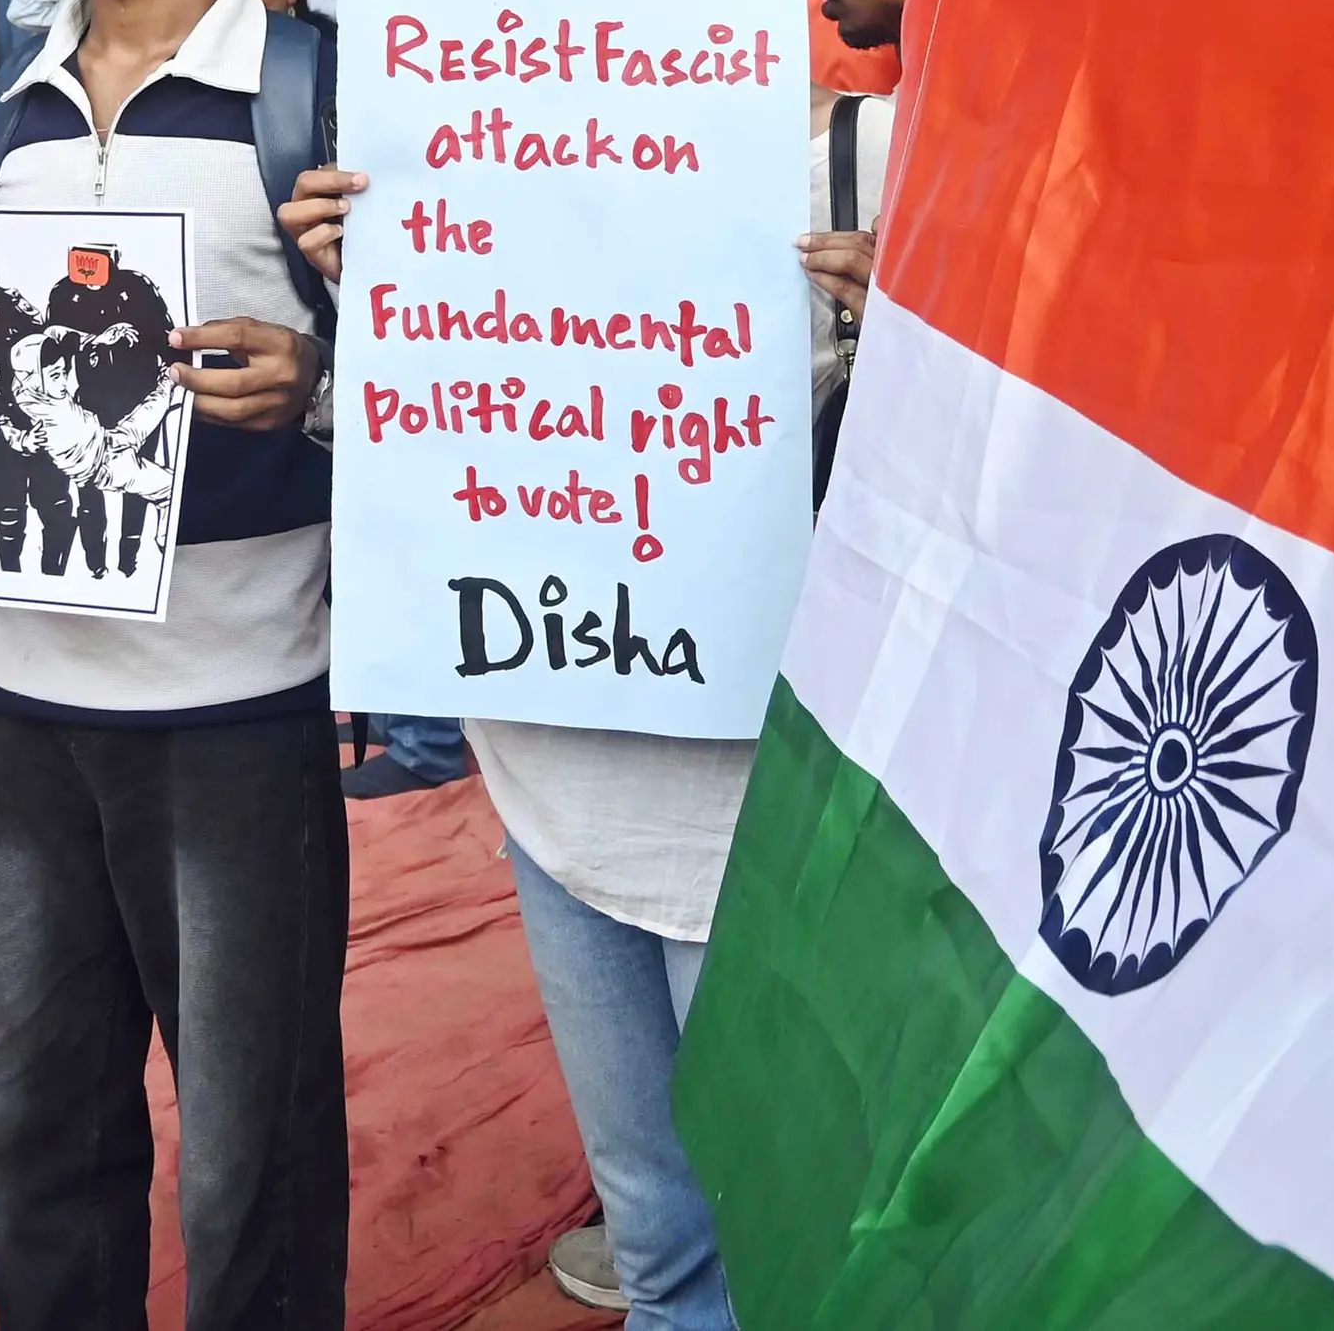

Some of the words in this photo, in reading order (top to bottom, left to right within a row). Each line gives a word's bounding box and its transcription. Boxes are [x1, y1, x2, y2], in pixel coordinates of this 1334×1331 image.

[594, 20, 781, 87] Fascist
[424, 106, 623, 171] attack
[631, 132, 700, 174] on
[401, 198, 494, 256] the
[369, 283, 753, 368] Fundamental
[631, 384, 775, 485] right
[453, 466, 508, 523] to
[520, 468, 664, 563] vote!
[448, 574, 706, 685] Disha
